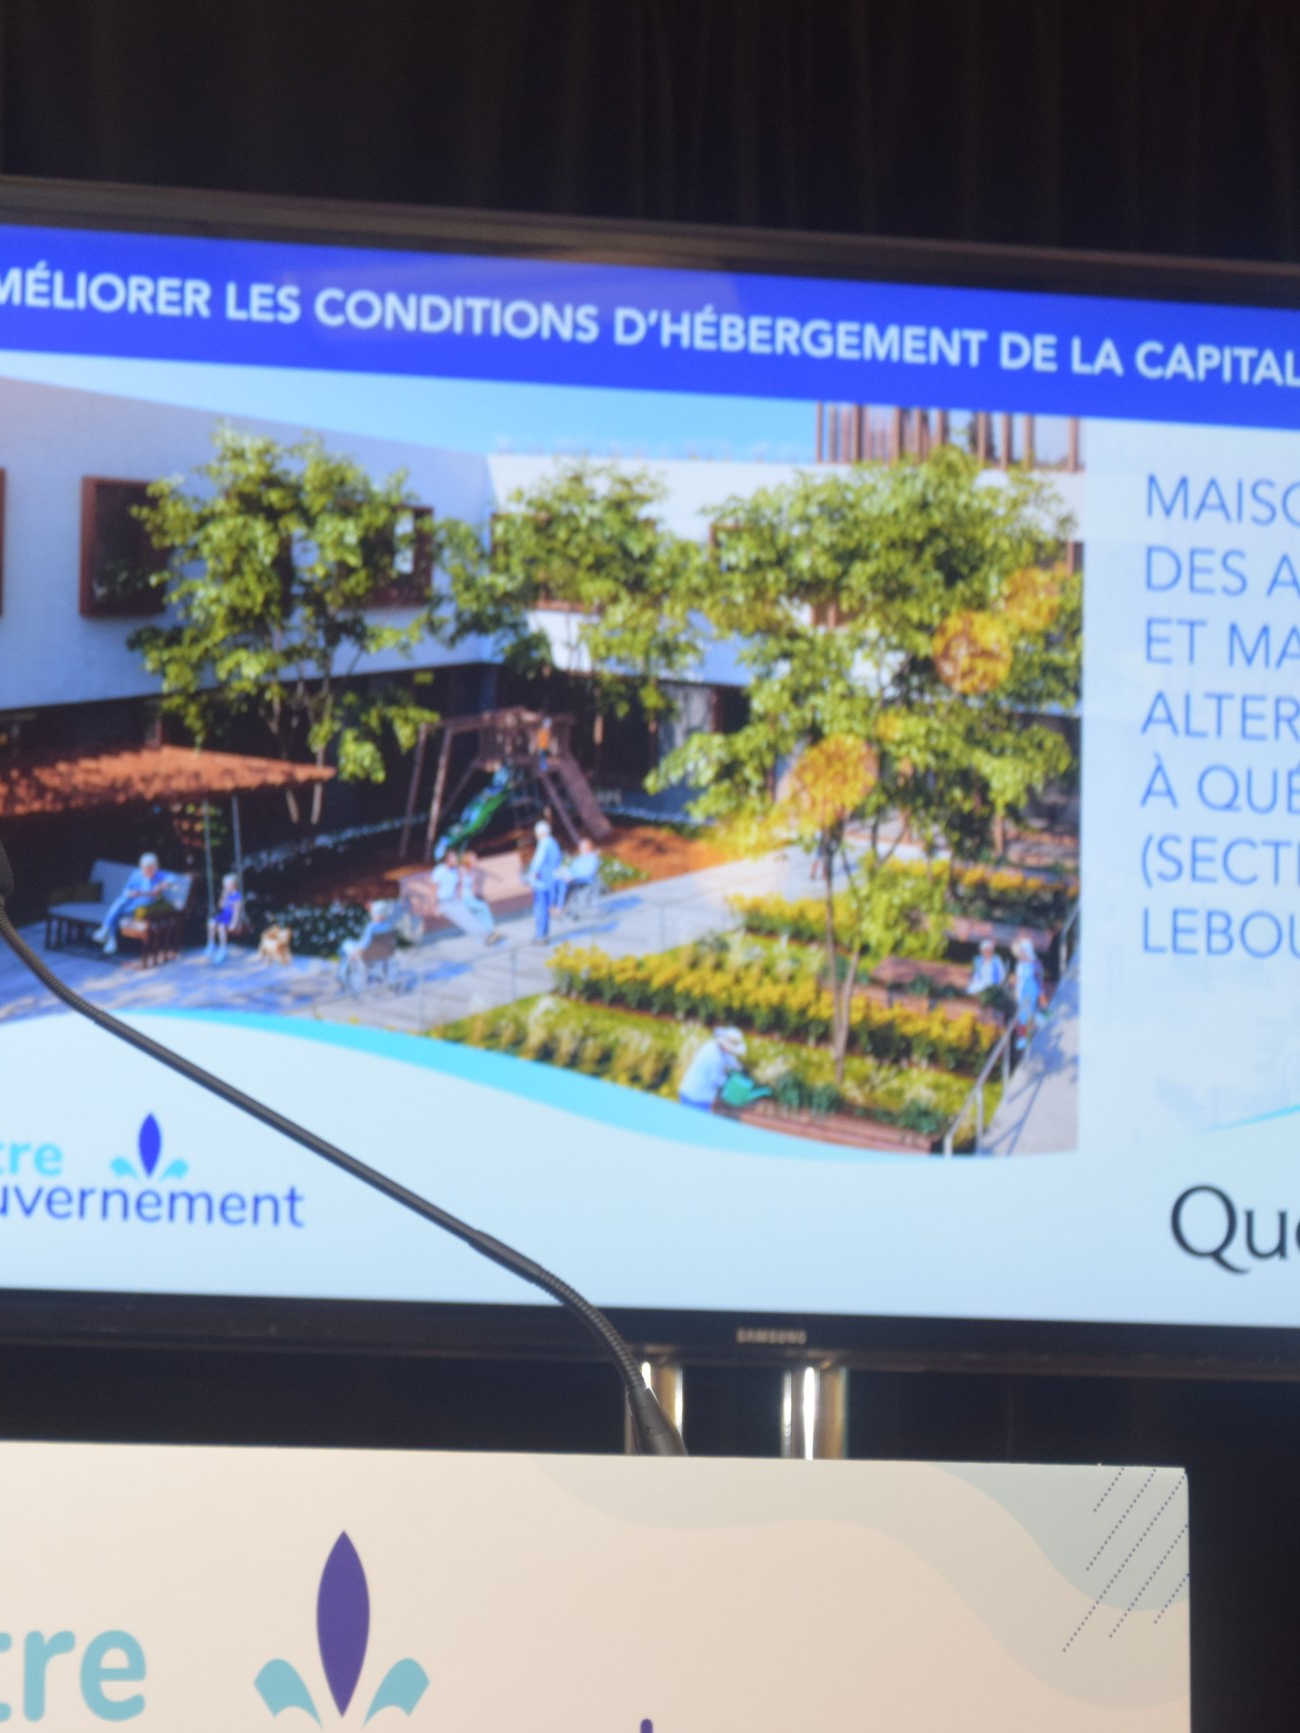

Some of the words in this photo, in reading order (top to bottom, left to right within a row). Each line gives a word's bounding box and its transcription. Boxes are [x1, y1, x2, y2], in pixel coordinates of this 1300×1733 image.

[225, 282, 300, 324] LES
[313, 288, 600, 343] CONDITIONS
[1001, 331, 1058, 372] DE
[1072, 337, 1125, 377] LA
[1134, 339, 1300, 388] CAPITAL
[1146, 545, 1249, 596] DES
[1146, 617, 1208, 666] ET
[1140, 751, 1179, 810] À
[1170, 1184, 1300, 1275] Qu
[736, 1327, 807, 1344] SAMSUNG
